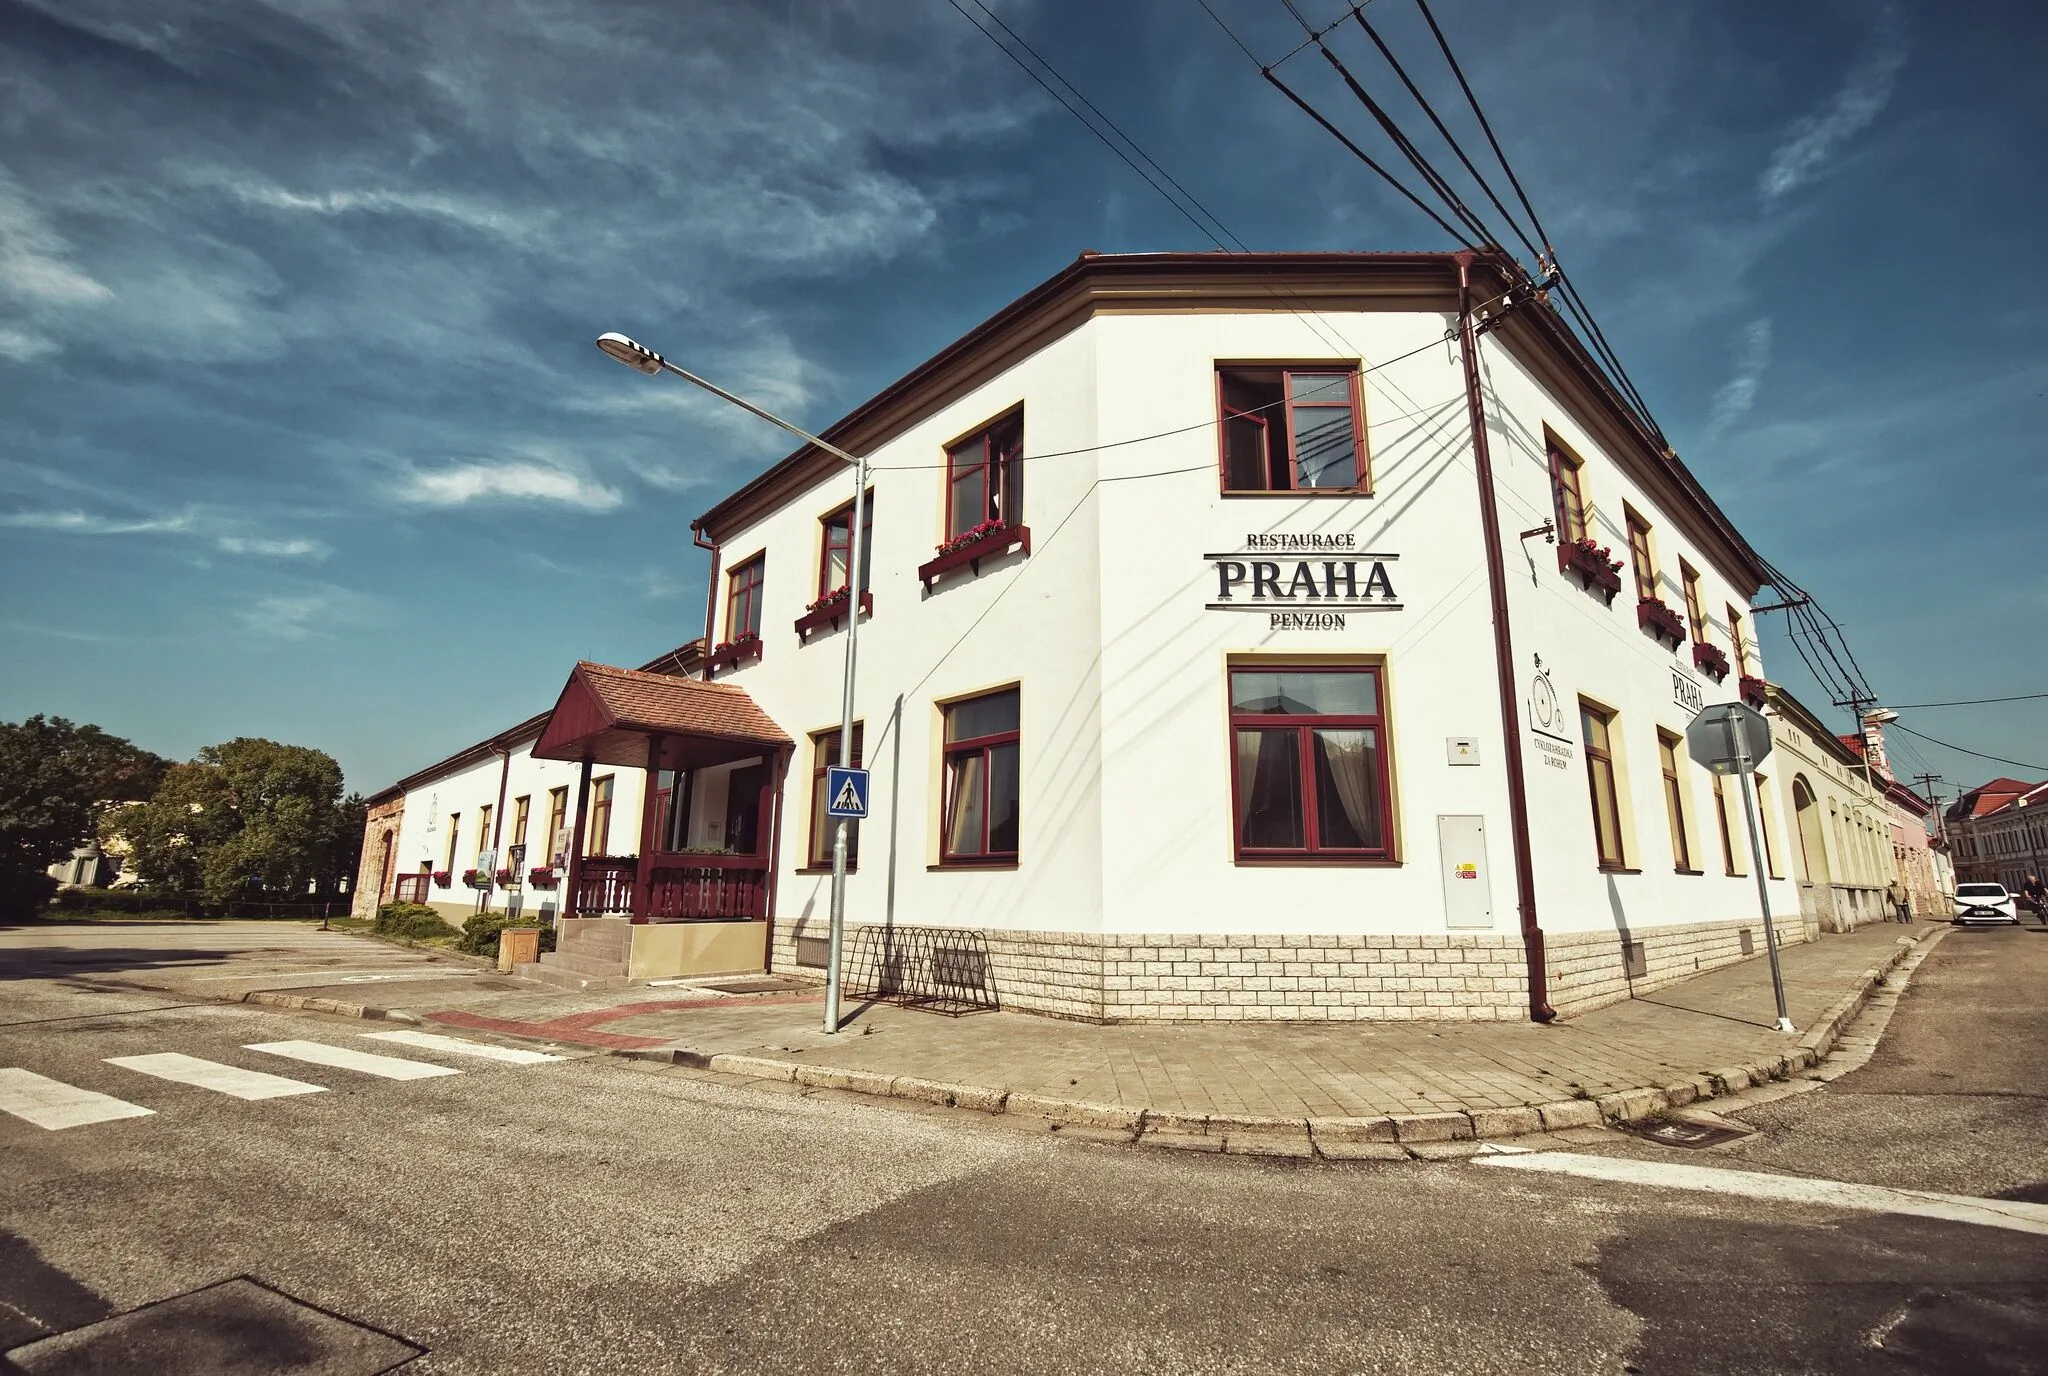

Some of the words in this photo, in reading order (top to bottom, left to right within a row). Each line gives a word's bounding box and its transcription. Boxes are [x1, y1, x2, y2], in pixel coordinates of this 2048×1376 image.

[1246, 533, 1356, 547] RESTAURACE
[1215, 561, 1398, 598] PRAHA
[1269, 613, 1346, 627] PENZION
[1672, 673, 1704, 712] PRAHA
